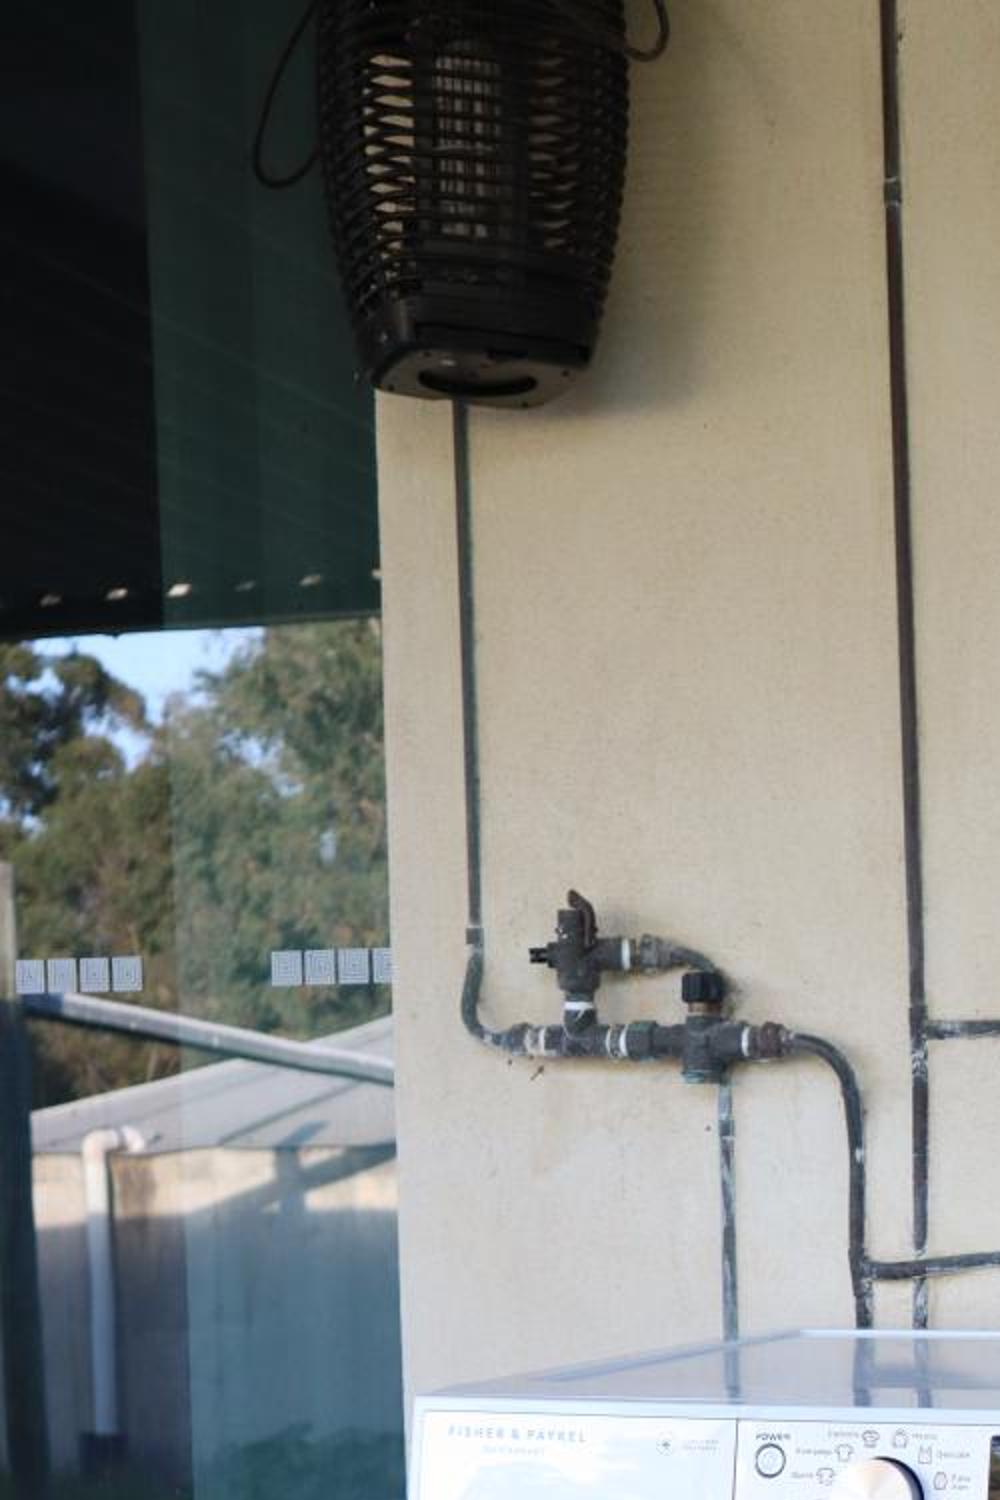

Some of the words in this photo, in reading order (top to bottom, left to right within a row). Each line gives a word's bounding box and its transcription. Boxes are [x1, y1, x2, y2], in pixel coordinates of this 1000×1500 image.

[447, 1424, 504, 1439] FISHER
[512, 1427, 520, 1440] &
[527, 1428, 587, 1443] PAYKEL
[756, 1432, 791, 1442] POWER
